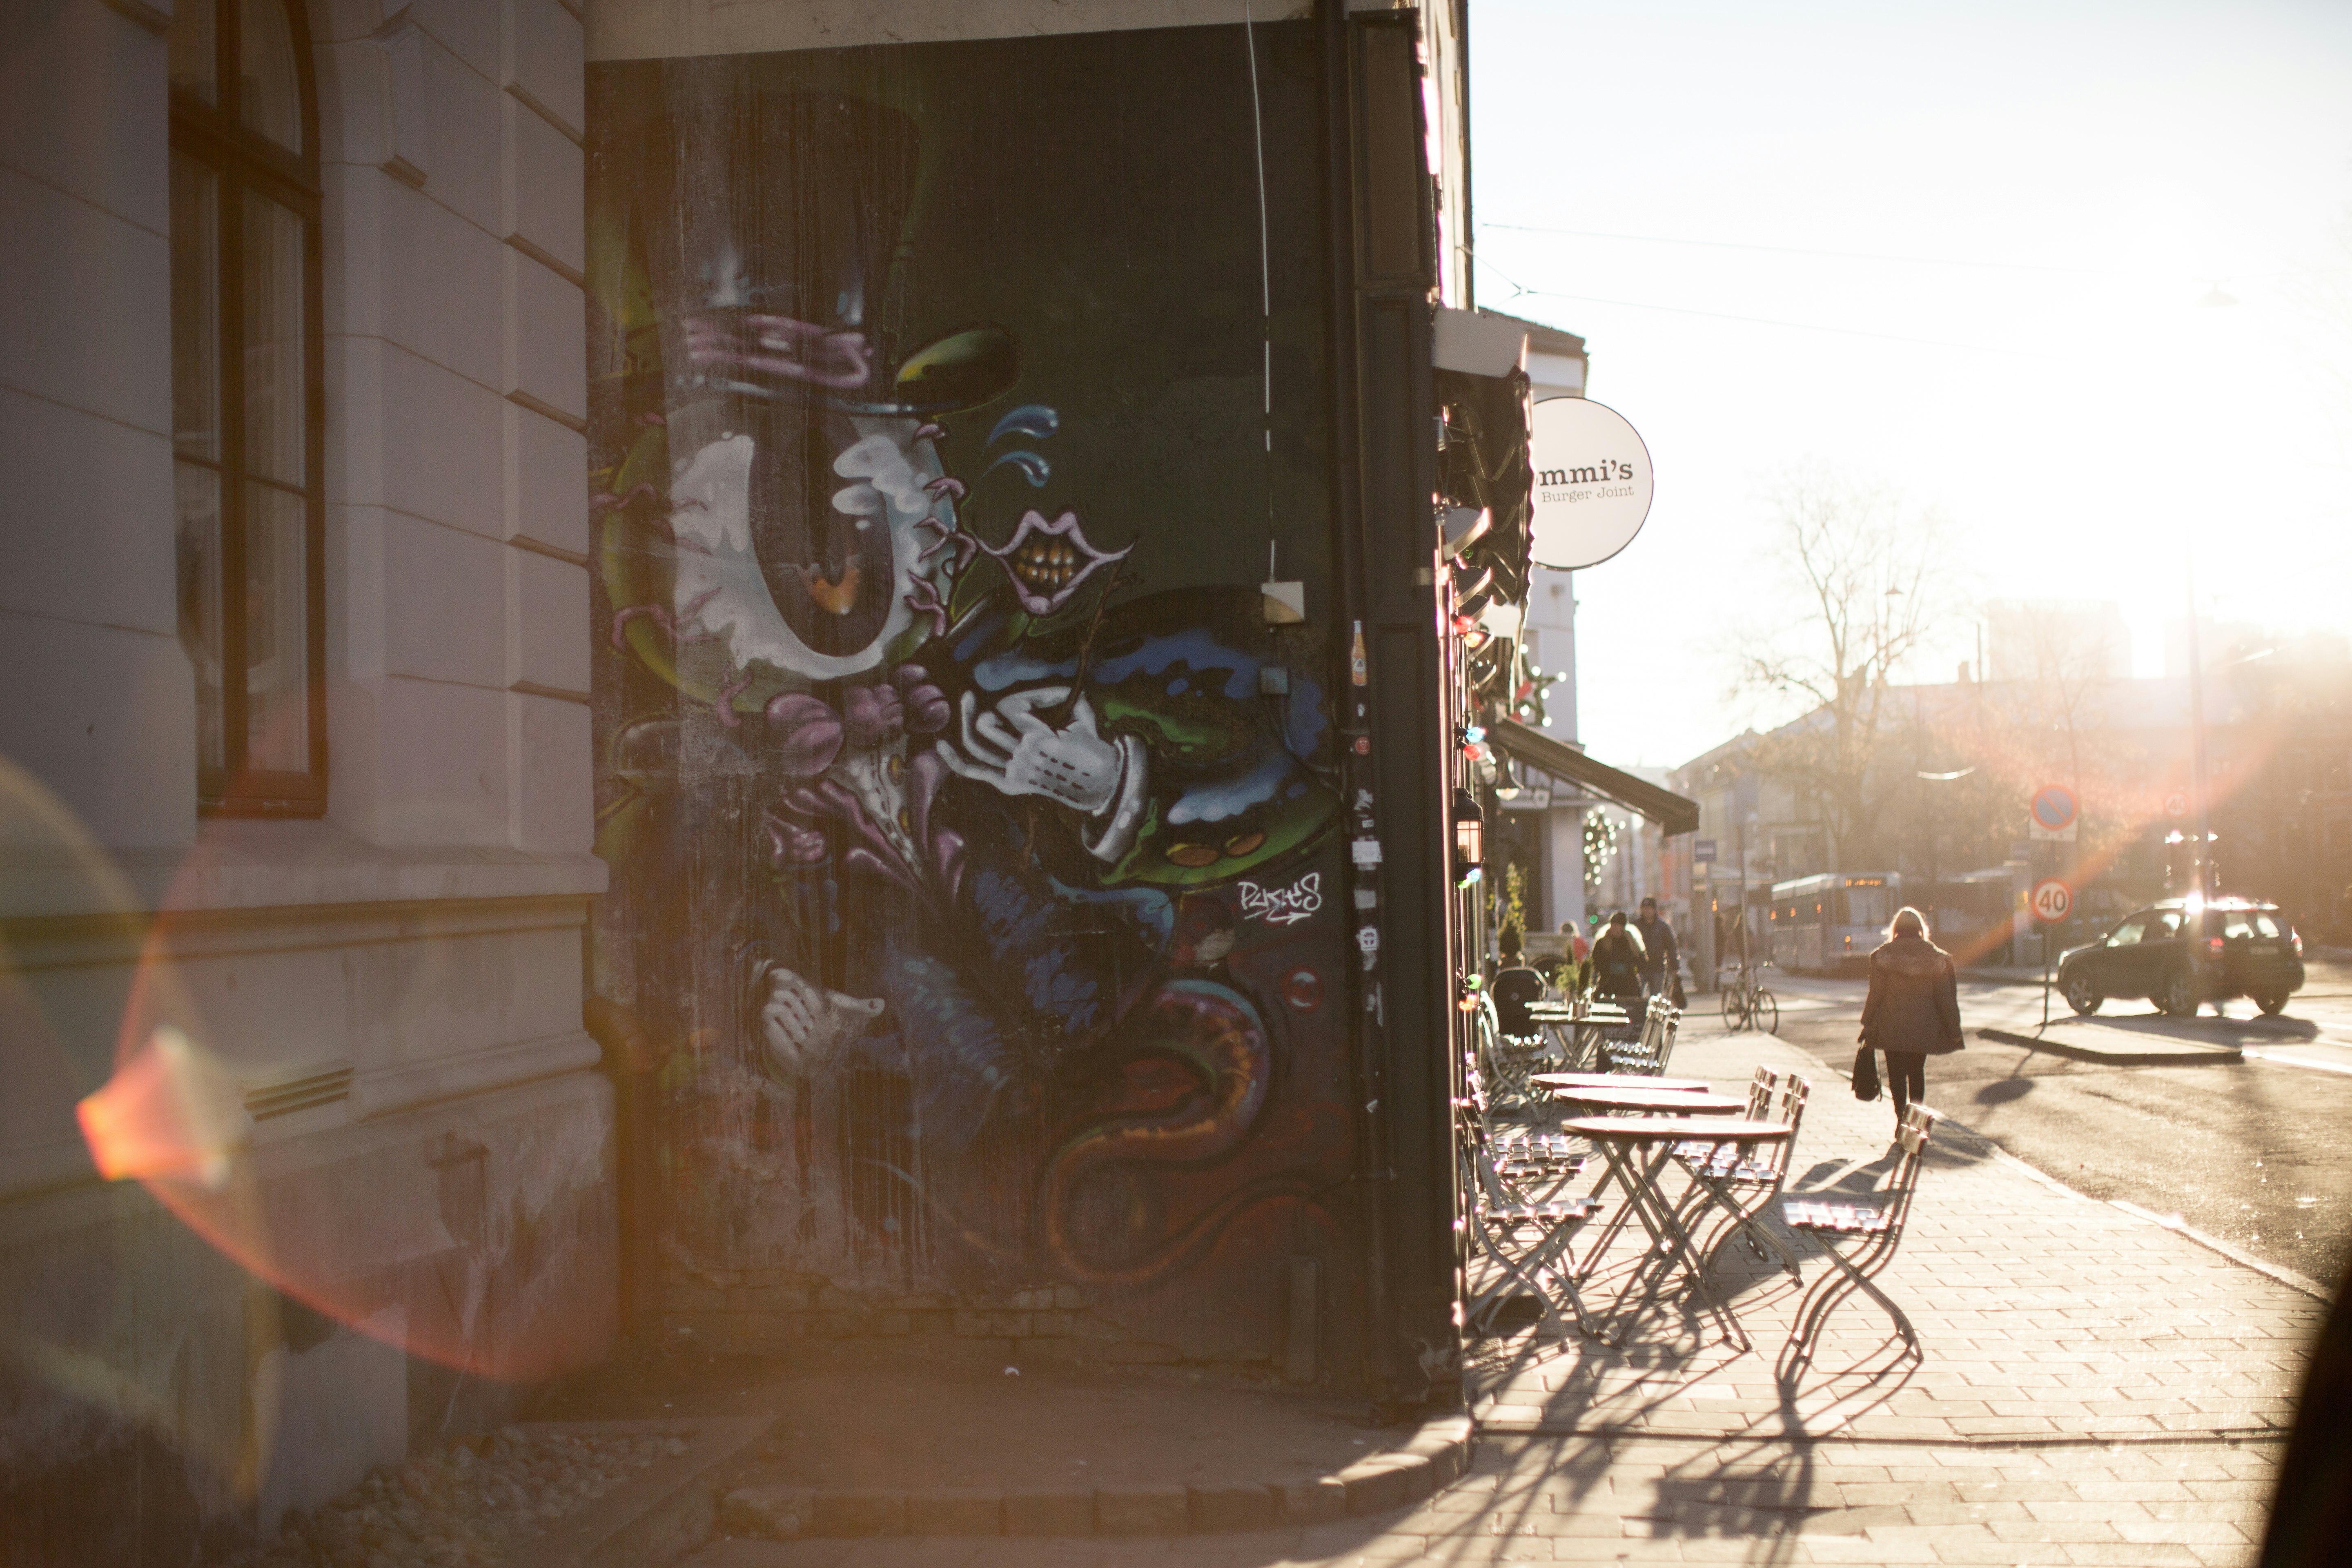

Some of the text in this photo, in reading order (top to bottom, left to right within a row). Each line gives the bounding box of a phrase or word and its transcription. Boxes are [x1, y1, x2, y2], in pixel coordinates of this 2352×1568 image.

[1536, 459, 1633, 486] mmi's
[1541, 485, 1635, 503] Burger Joint
[2039, 890, 2066, 912] 40
